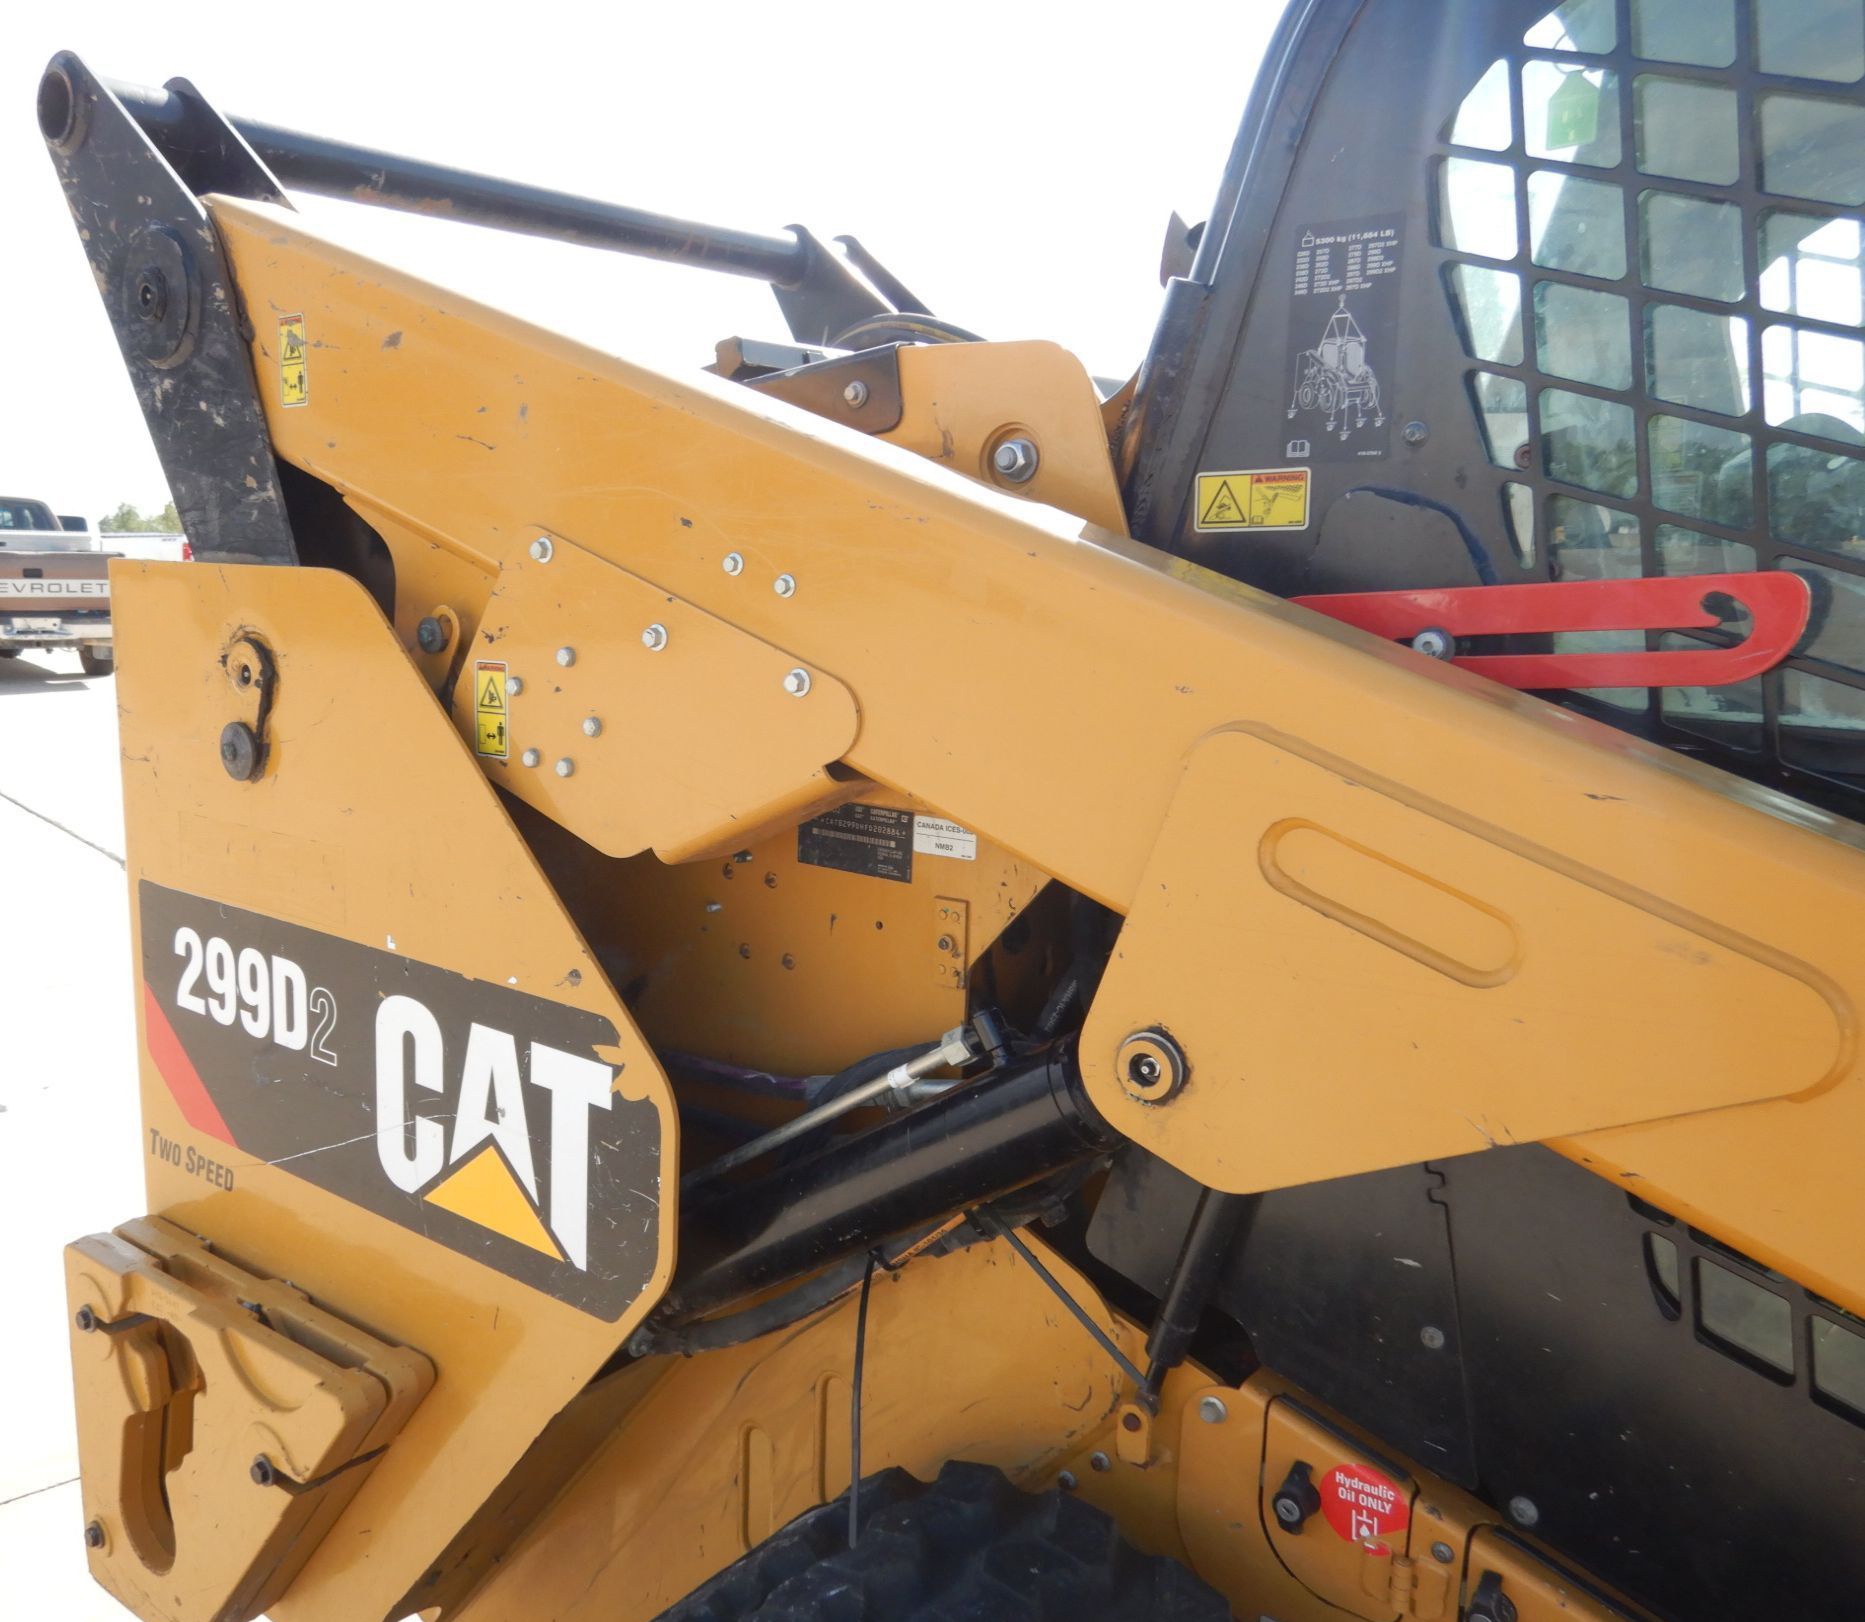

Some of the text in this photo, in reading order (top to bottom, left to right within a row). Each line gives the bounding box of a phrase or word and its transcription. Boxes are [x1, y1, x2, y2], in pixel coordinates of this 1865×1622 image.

[1264, 473, 1304, 484] WARNING
[0, 582, 108, 594] EVROLET
[916, 821, 944, 832] CANADA
[376, 994, 613, 1272] CAT
[1335, 1471, 1395, 1501] Hydraulic
[1338, 1486, 1392, 1515] Oil ONLY
